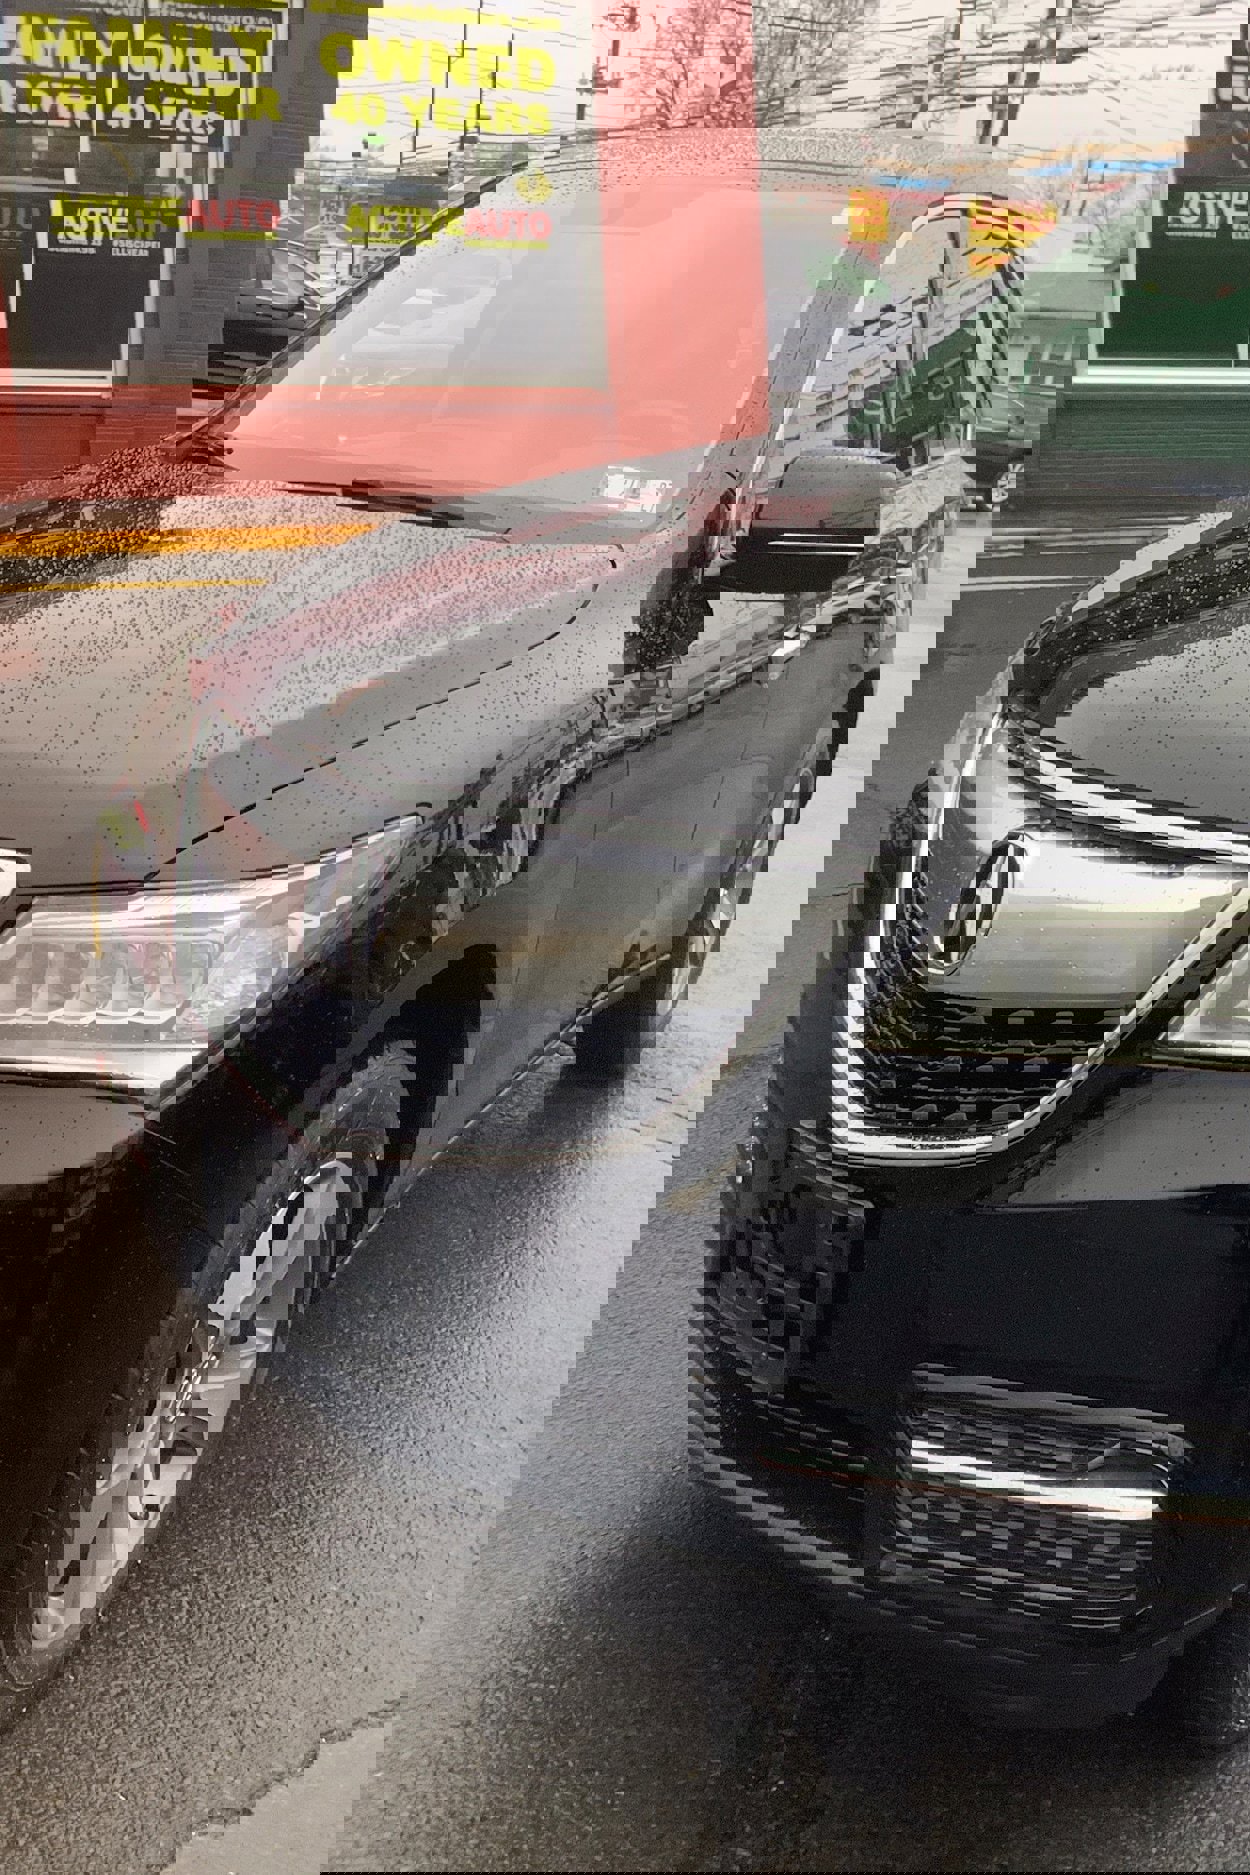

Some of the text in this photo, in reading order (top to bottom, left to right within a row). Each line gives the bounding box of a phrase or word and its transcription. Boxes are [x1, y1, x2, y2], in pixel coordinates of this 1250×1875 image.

[319, 32, 556, 92] OWNED
[331, 91, 553, 136] 40 YEARS
